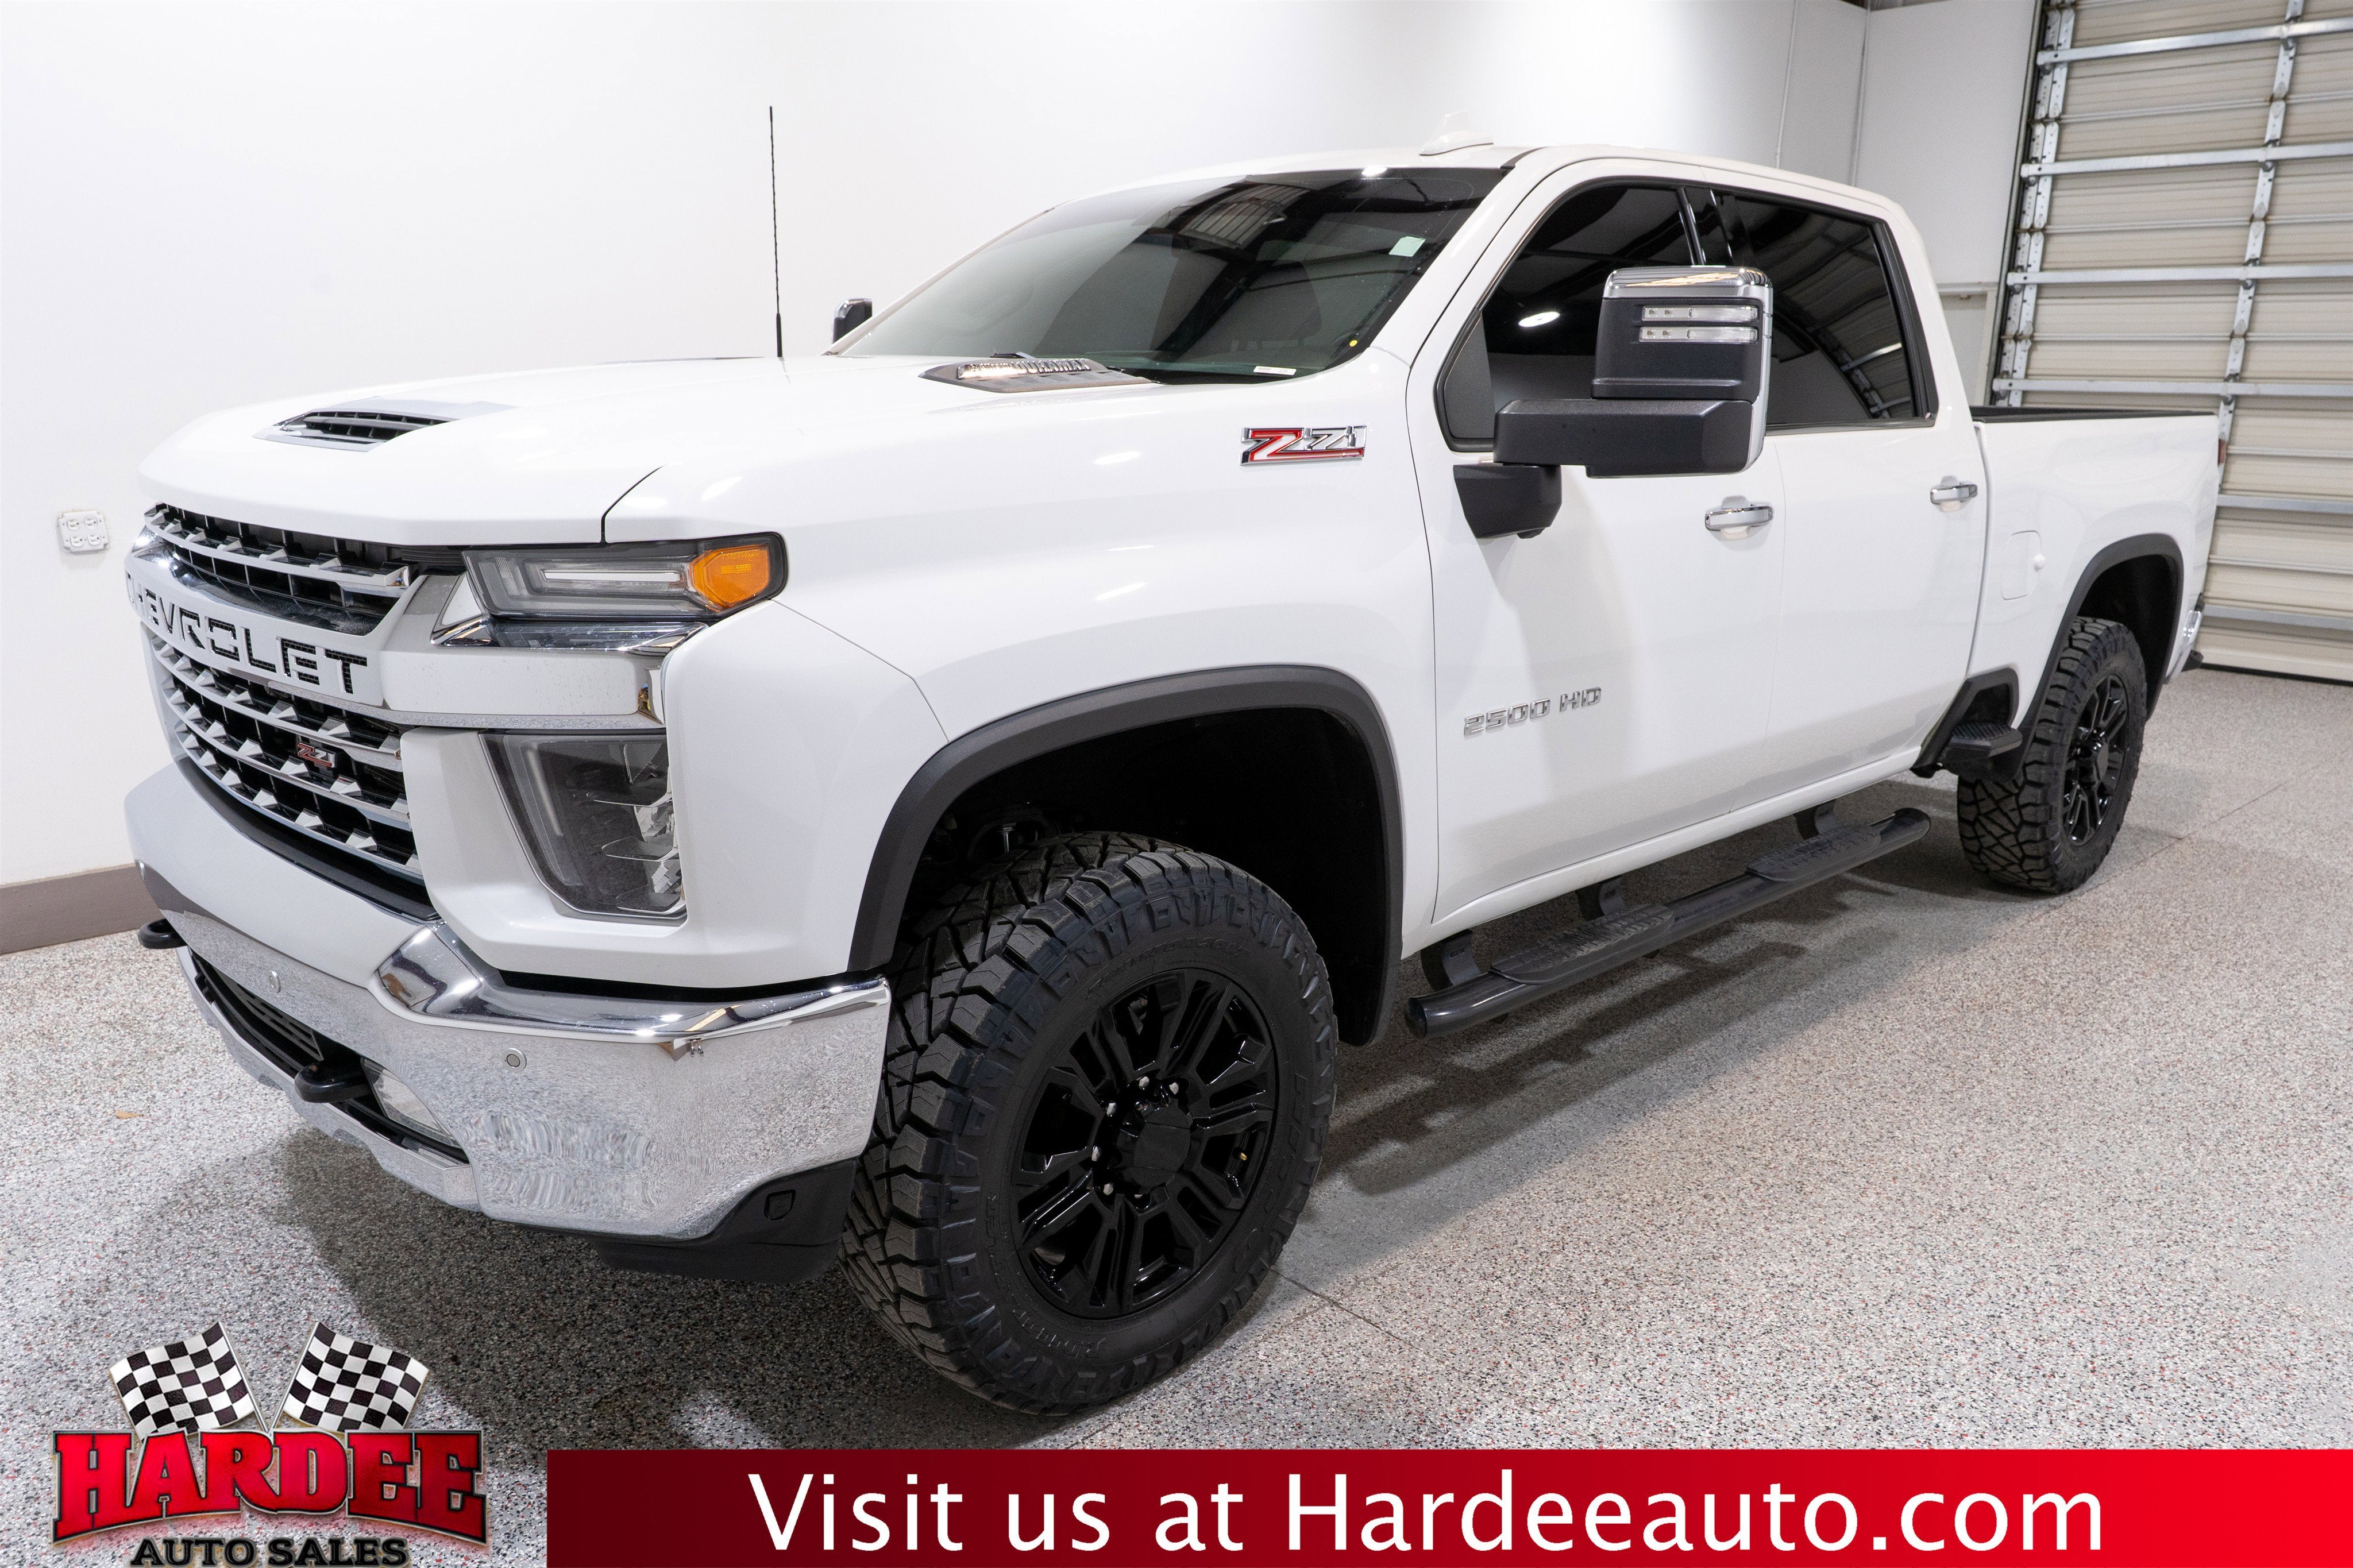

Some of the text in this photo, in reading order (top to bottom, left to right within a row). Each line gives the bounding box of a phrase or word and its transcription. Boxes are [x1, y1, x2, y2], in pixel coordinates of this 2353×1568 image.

[1240, 425, 1367, 466] Z71
[125, 570, 368, 695] CHEVROLET
[1464, 687, 1602, 736] 2500 HD
